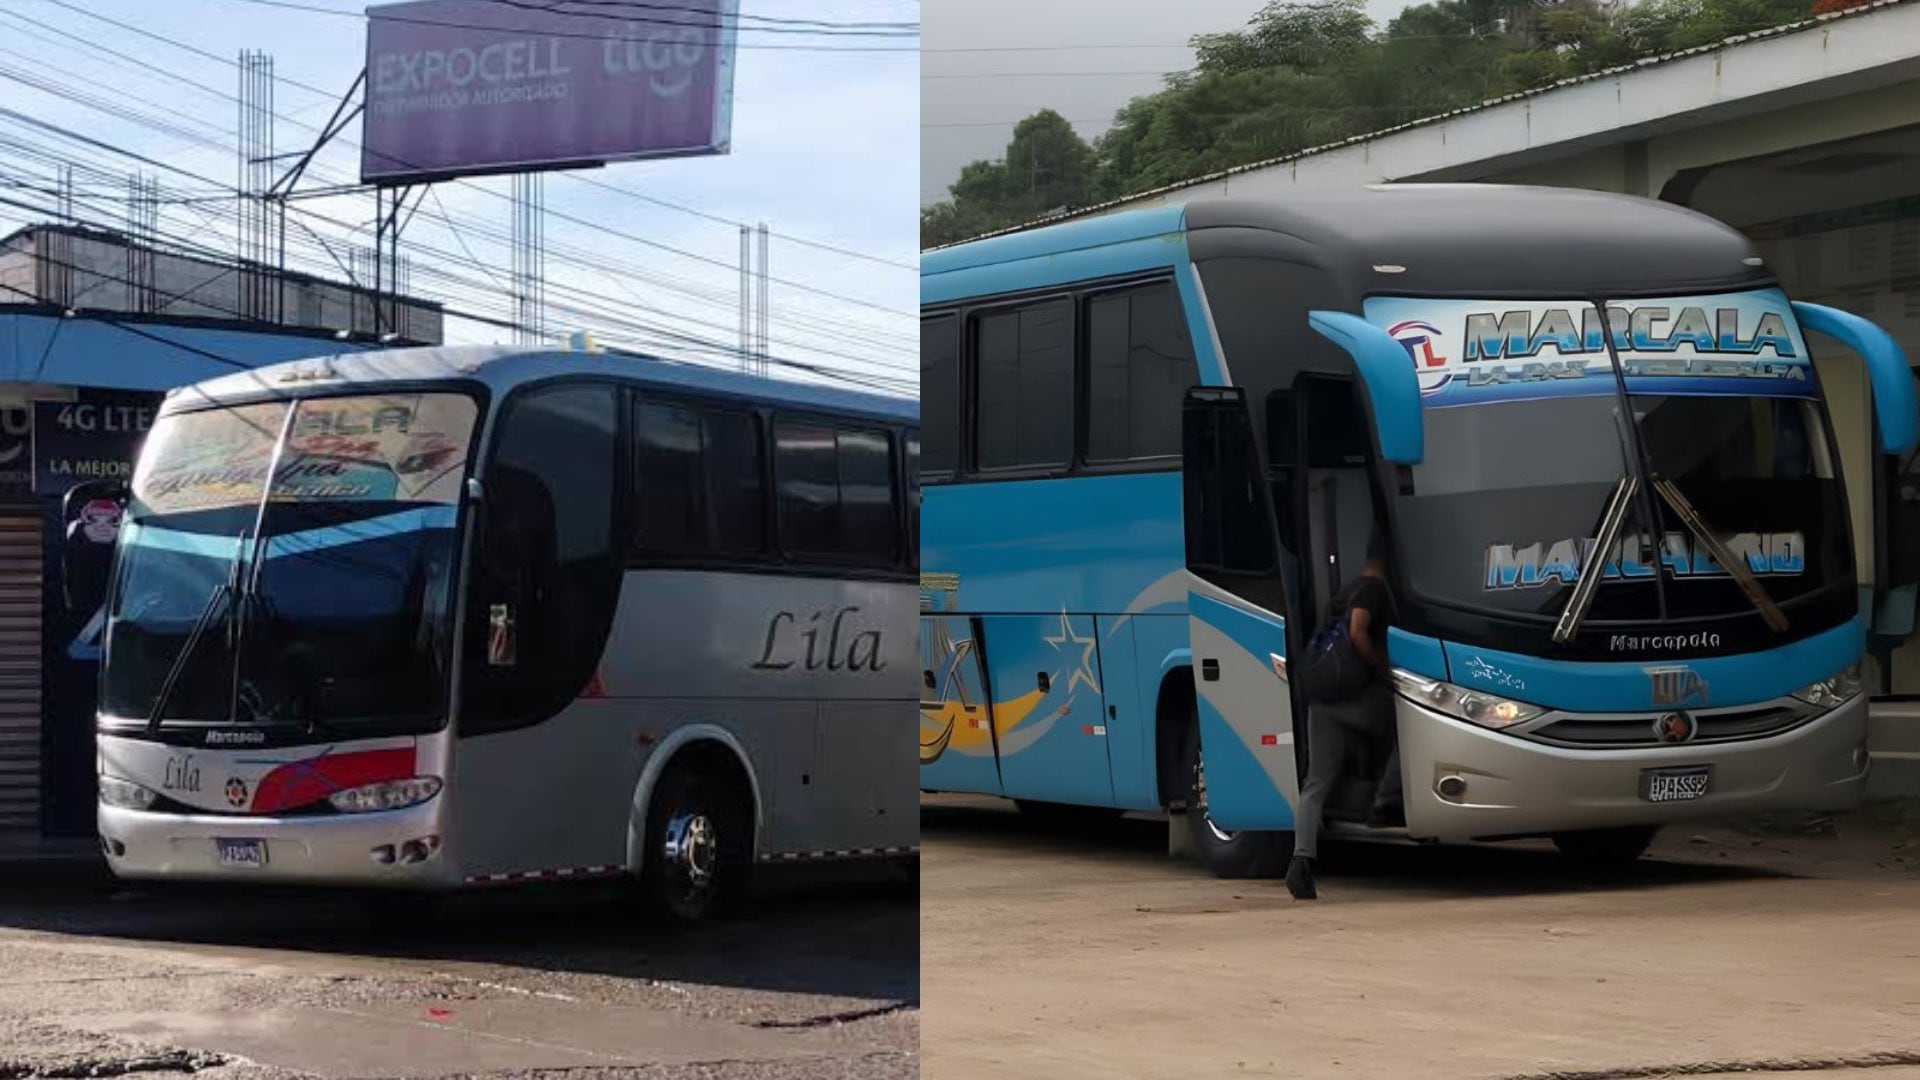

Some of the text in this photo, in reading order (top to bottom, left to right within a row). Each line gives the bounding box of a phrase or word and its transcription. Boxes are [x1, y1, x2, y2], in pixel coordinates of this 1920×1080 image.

[375, 36, 571, 95] EXPOCELL
[374, 95, 469, 114] DISTUIDOR
[1463, 306, 1797, 362] MARCALA
[57, 405, 149, 432] 4G LTE
[50, 459, 131, 478] LA MEJOR
[750, 606, 888, 672] Lila
[163, 755, 201, 792] Lila
